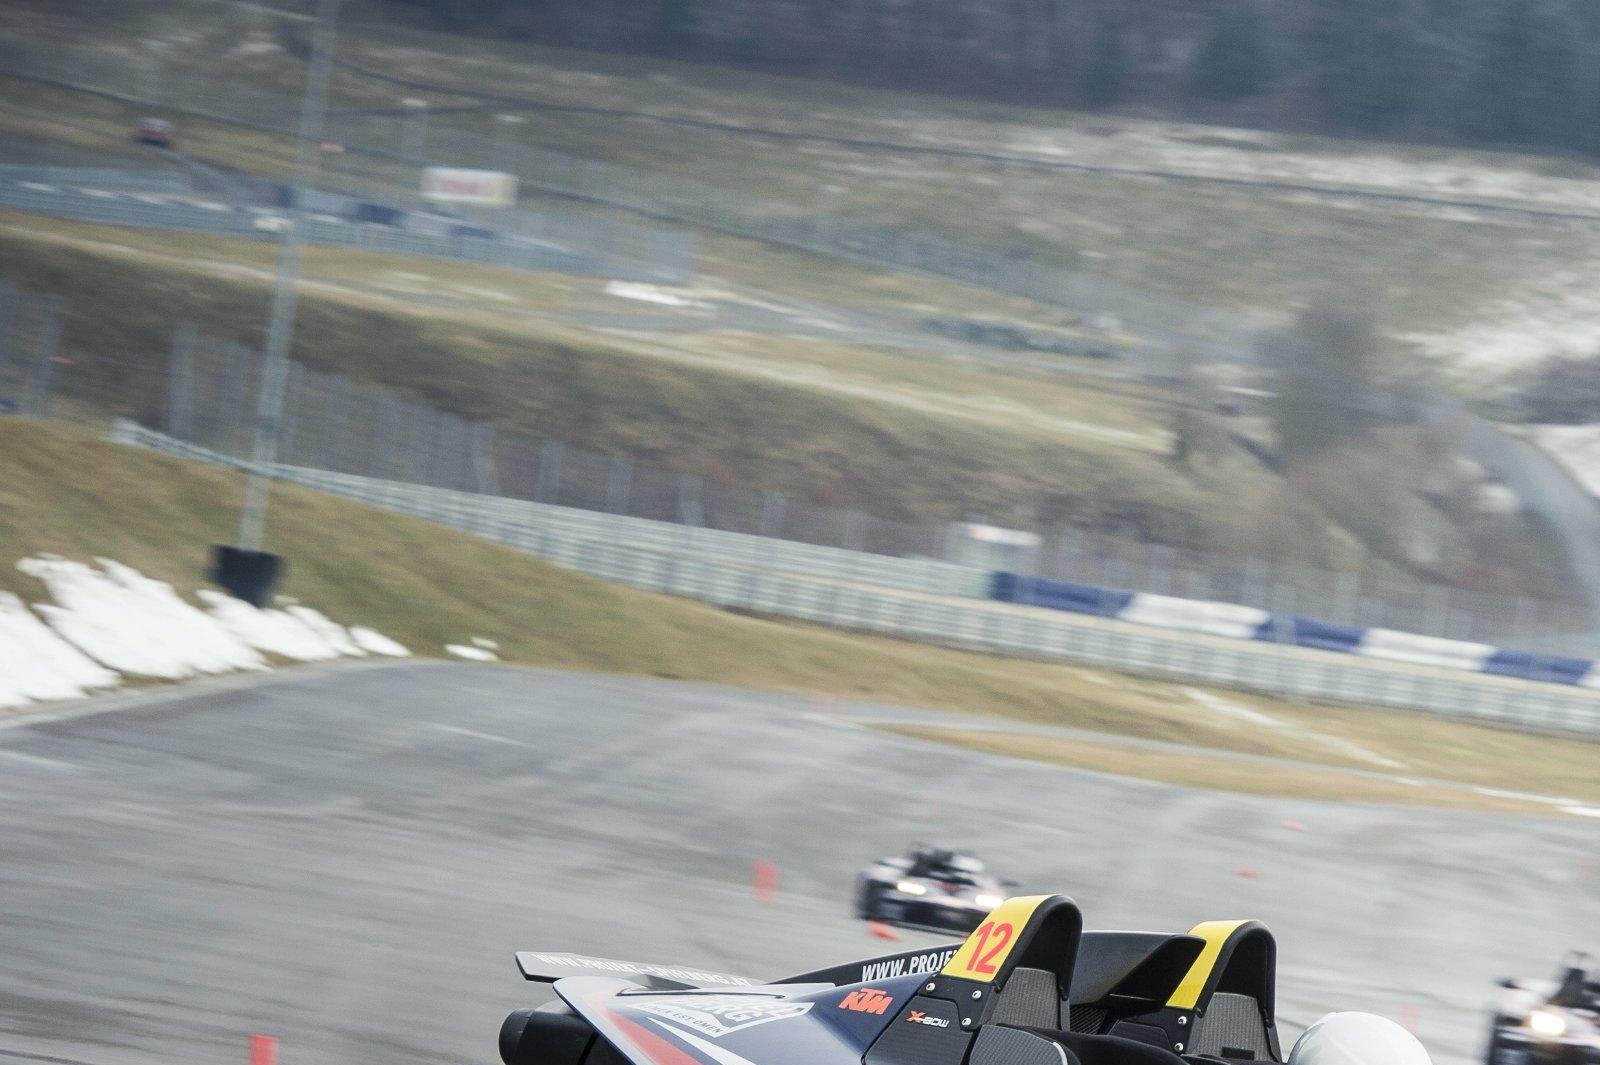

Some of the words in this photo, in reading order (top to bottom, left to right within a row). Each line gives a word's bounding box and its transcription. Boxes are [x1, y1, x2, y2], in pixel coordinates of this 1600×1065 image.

[966, 921, 1013, 974] 12
[861, 950, 957, 983] WWW.PROJE
[838, 986, 893, 1015] KTM
